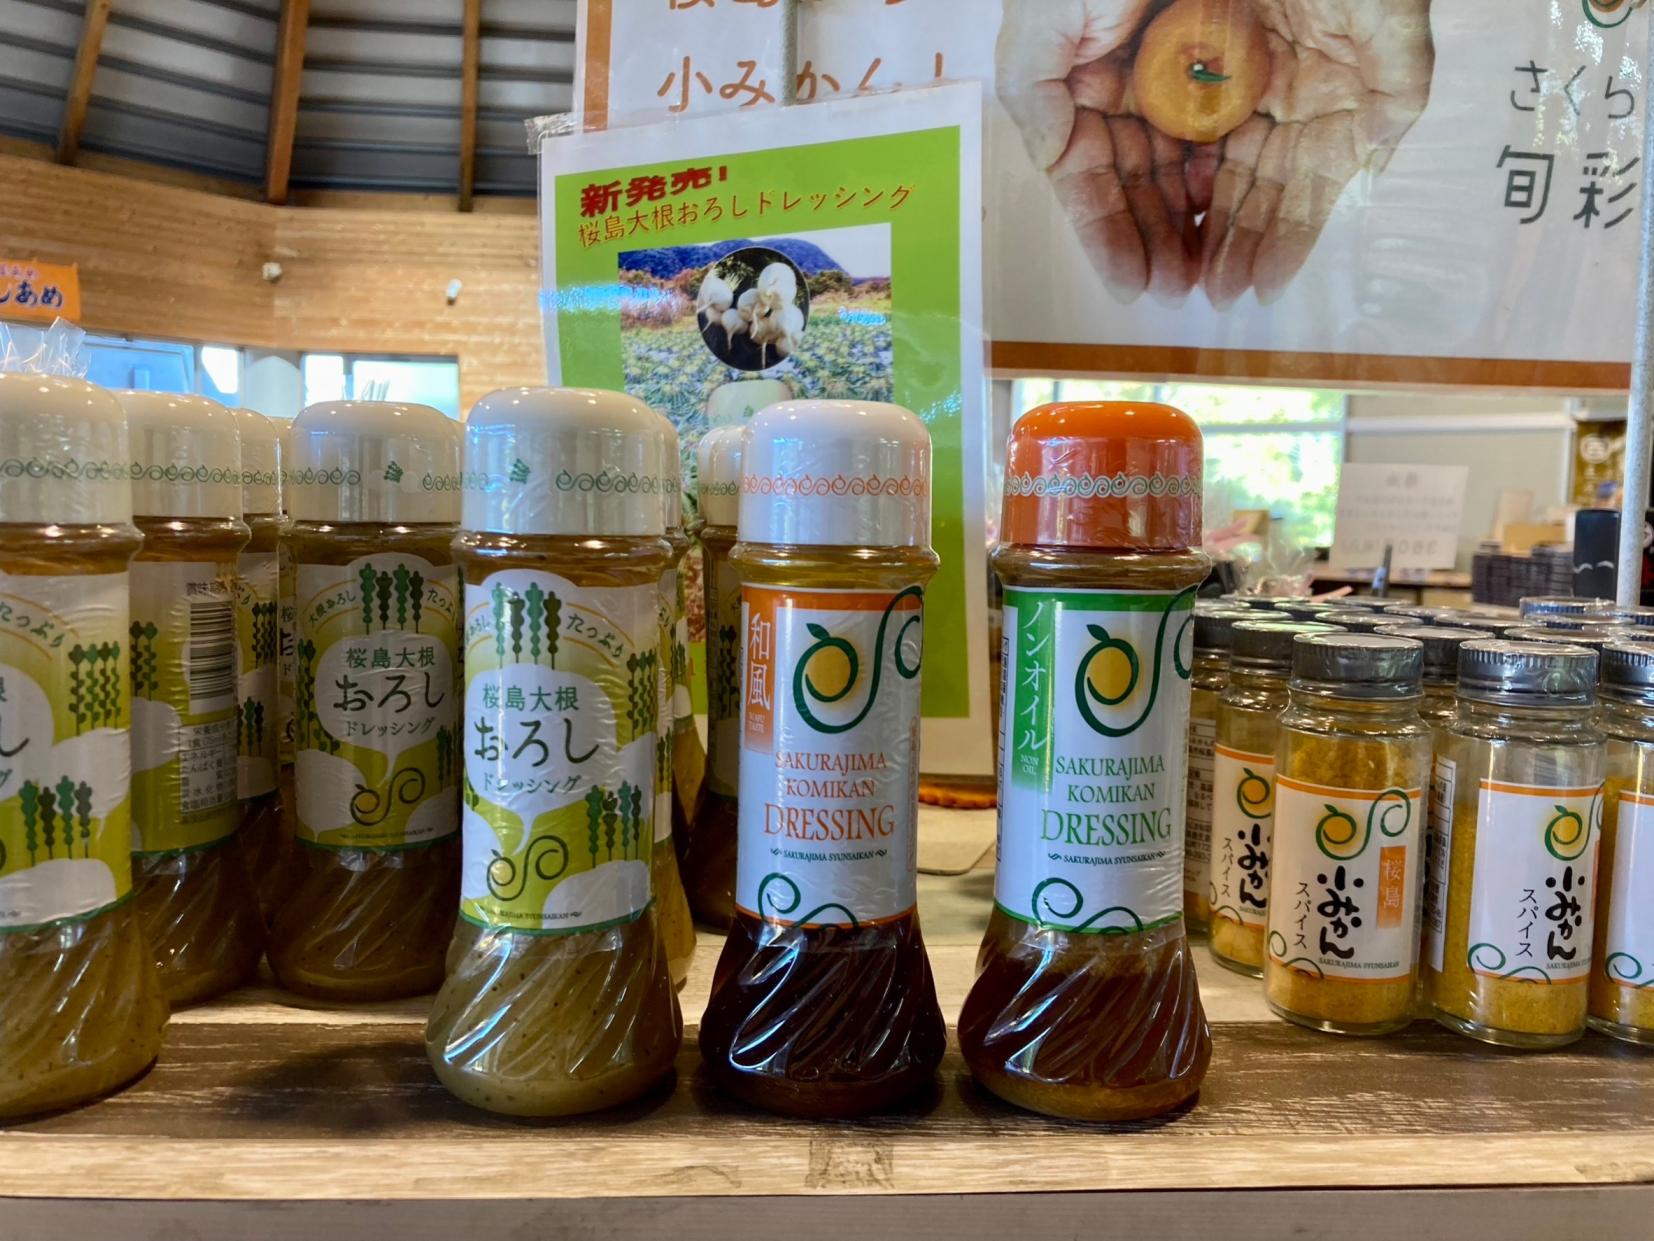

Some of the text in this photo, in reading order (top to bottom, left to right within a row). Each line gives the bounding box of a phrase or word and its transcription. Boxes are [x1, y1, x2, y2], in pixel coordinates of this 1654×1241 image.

[1510, 60, 1635, 119] さくら
[579, 165, 728, 218] 新発売!
[1496, 144, 1641, 229] 旬彩
[577, 182, 914, 248] 桜島大根おろしドレッシング
[308, 589, 357, 626] 大根おろし
[345, 645, 436, 669] 桜島大根
[567, 613, 624, 659] たっぷり
[748, 612, 771, 711] 和風
[1017, 602, 1049, 751] ノンオイル
[332, 671, 445, 714] おろし
[481, 684, 579, 713] 桜島大根
[346, 715, 436, 738] ドレッシング
[474, 716, 600, 767] おろし
[482, 772, 582, 795] ドレッシング
[776, 752, 887, 778] SAKURAJIMA
[786, 779, 875, 799] KOMIKAN
[1056, 755, 1165, 782] SAKURAJIMA
[1067, 783, 1155, 803] KOMIKAN
[763, 802, 896, 841] DRESSING
[1040, 807, 1172, 846] DRESSING
[1221, 837, 1235, 899] スパイス
[1237, 823, 1270, 909] 小みかん
[1382, 860, 1402, 909] 桜島
[1293, 881, 1312, 950] スパイス
[1316, 865, 1364, 959] 小みかん
[1515, 888, 1538, 958] スパイス
[1544, 866, 1586, 960] 小みかん
